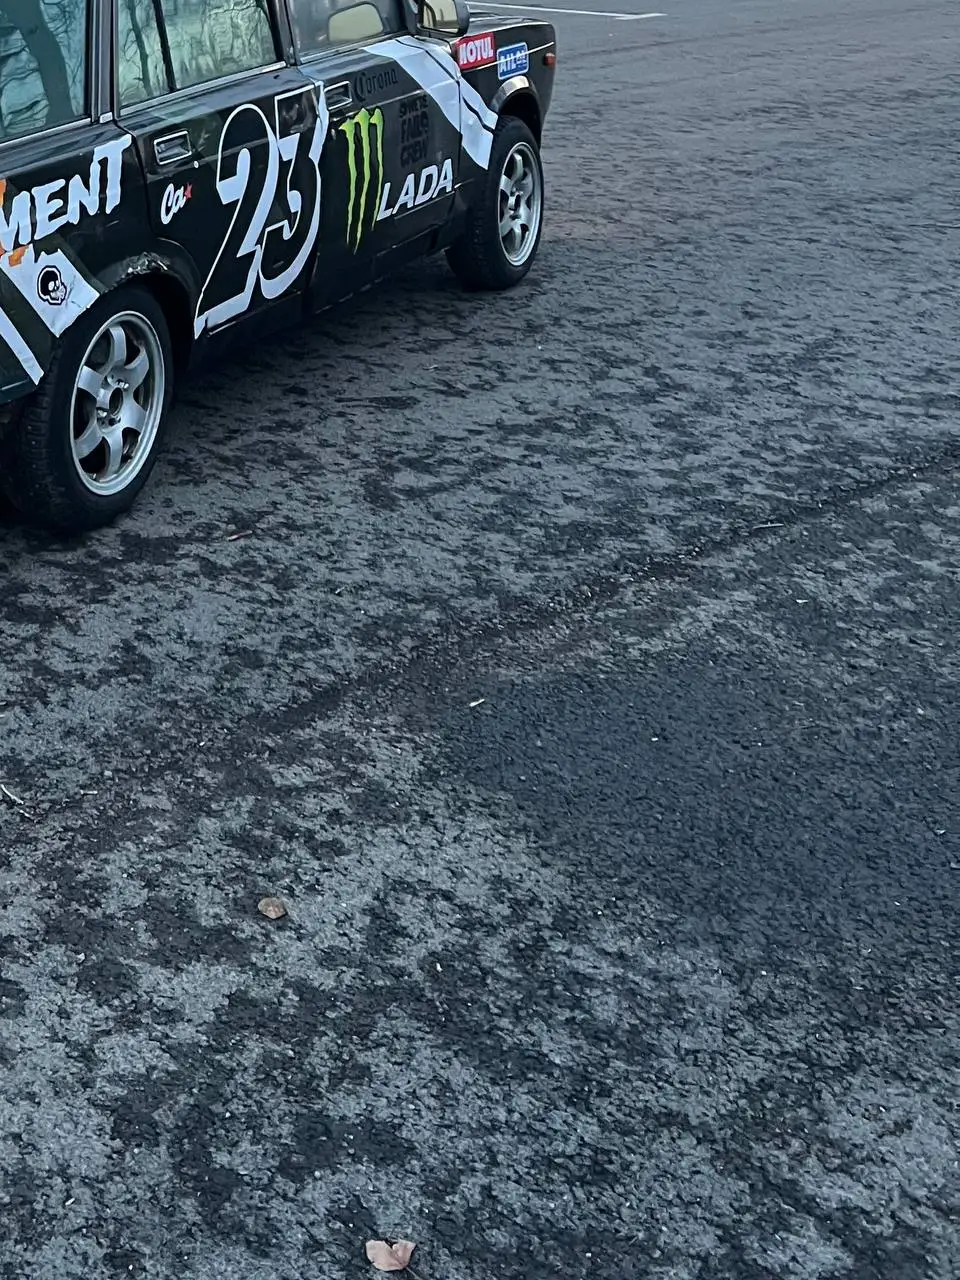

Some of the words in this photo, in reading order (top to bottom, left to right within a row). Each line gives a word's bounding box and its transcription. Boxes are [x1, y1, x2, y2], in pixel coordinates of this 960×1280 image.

[458, 36, 494, 66] MOTUL
[353, 69, 398, 102] Corona
[194, 81, 330, 339] 23
[376, 159, 454, 221] LADA
